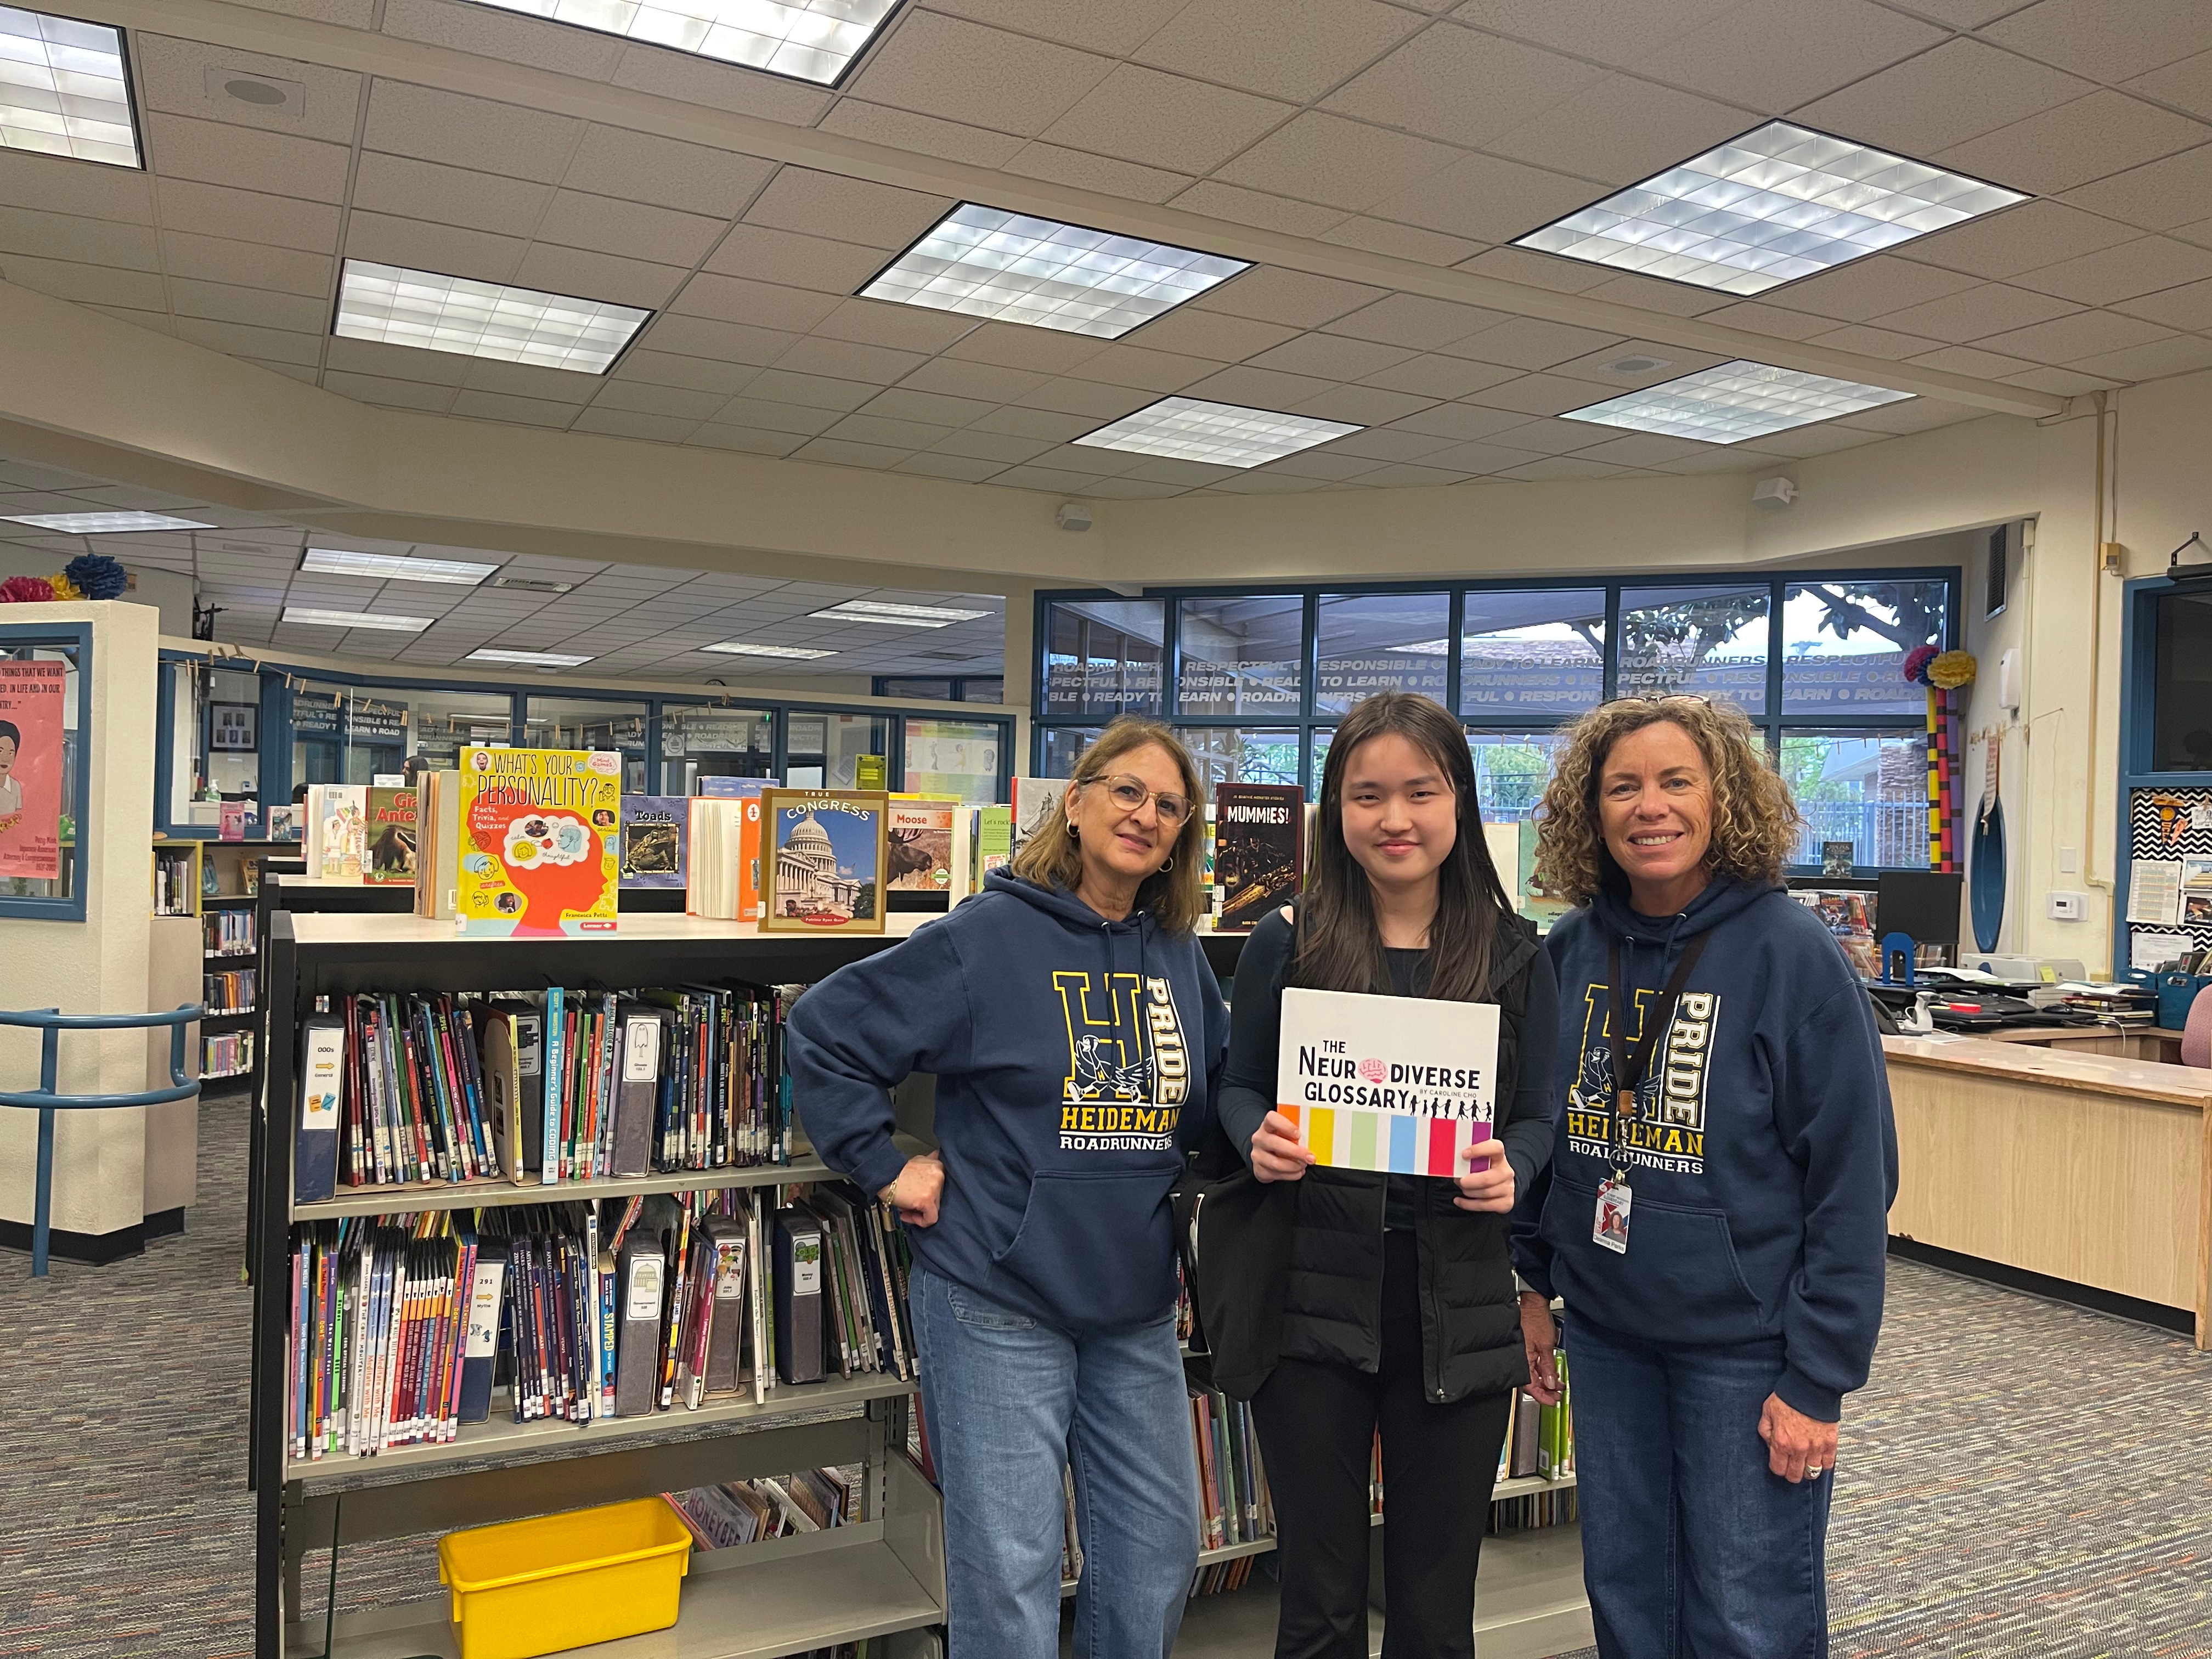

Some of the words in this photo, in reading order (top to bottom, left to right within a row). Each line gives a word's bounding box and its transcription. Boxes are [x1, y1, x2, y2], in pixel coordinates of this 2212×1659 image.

[1185, 661, 1288, 672] RESPECTFUL
[1318, 659, 1426, 671] ESPONSIBLE
[1463, 658, 1510, 669] EADY
[1512, 658, 1535, 669] TO
[1539, 658, 1598, 669] LEARN
[1619, 655, 1767, 668] ROADRUNNERS
[1785, 653, 1905, 666] RESPECTFU
[2, 668, 21, 677] THINGS
[22, 668, 36, 677] THAT
[37, 668, 46, 677] WE
[47, 668, 63, 677] WANT
[1262, 676, 1301, 686] READ
[1321, 675, 1342, 687] TO
[1347, 675, 1402, 686] LEARN
[10, 684, 16, 693] IN
[17, 684, 28, 693] LIFE
[30, 684, 41, 693] AND
[42, 684, 47, 693] IN
[49, 684, 60, 693] OUR
[1094, 692, 1144, 702] READY
[1180, 692, 1222, 702] EARN
[1739, 689, 1765, 701] TO
[1782, 689, 1831, 700] EARN
[494, 753, 537, 775] WHAT'S
[544, 754, 572, 775] YOUR
[393, 793, 417, 808] Gia
[478, 775, 598, 808] PERSONALITY?
[635, 810, 672, 822] Toads
[787, 800, 870, 821] CONGRESS
[897, 814, 927, 824] Moose
[1227, 805, 1289, 824] MUMMIES!
[542, 851, 570, 860] thoughtful
[439, 1015, 447, 1031] EPIC
[1147, 976, 1187, 1104] PRIDE
[1323, 1040, 1346, 1053] THE
[550, 1048, 559, 1091] Beginner's
[1664, 992, 1714, 1128] PRIDE
[549, 1093, 557, 1116] Guide
[1305, 1081, 1409, 1109] GLOSSARY
[549, 1118, 556, 1126] to
[1060, 1107, 1181, 1132] HEIDEMAN
[1060, 1136, 1172, 1150] ROADRUNNERS
[1567, 1113, 1704, 1156] HEIEMAN
[884, 1268, 891, 1278] WE
[897, 1266, 908, 1300] CROSSINGS
[887, 1295, 896, 1319] PEOPLE
[604, 1312, 614, 1351] STAMPED
[366, 1355, 374, 1386] Meditate
[376, 1354, 385, 1386] Meditate
[364, 1407, 370, 1419] Me
[373, 1407, 380, 1418] Me
